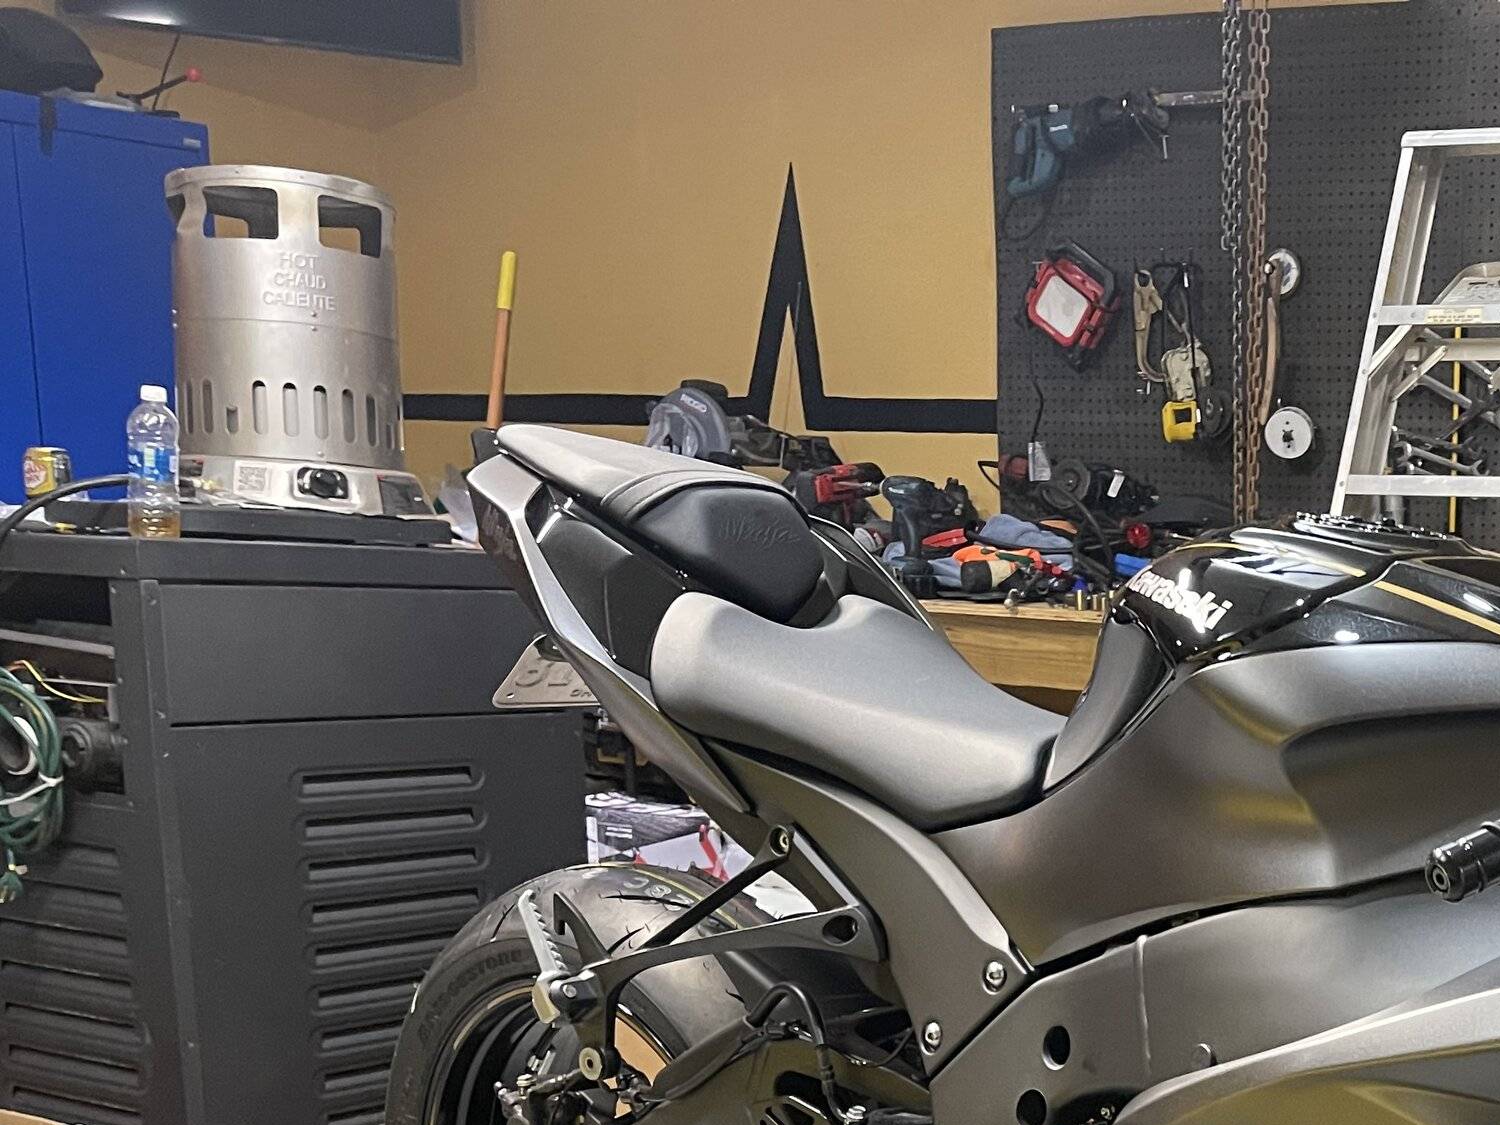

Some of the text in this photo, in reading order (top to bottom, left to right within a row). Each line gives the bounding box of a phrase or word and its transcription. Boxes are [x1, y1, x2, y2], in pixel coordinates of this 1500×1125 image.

[279, 252, 319, 269] HOT
[273, 271, 328, 290] CHAUD
[262, 291, 337, 311] CALIENTE
